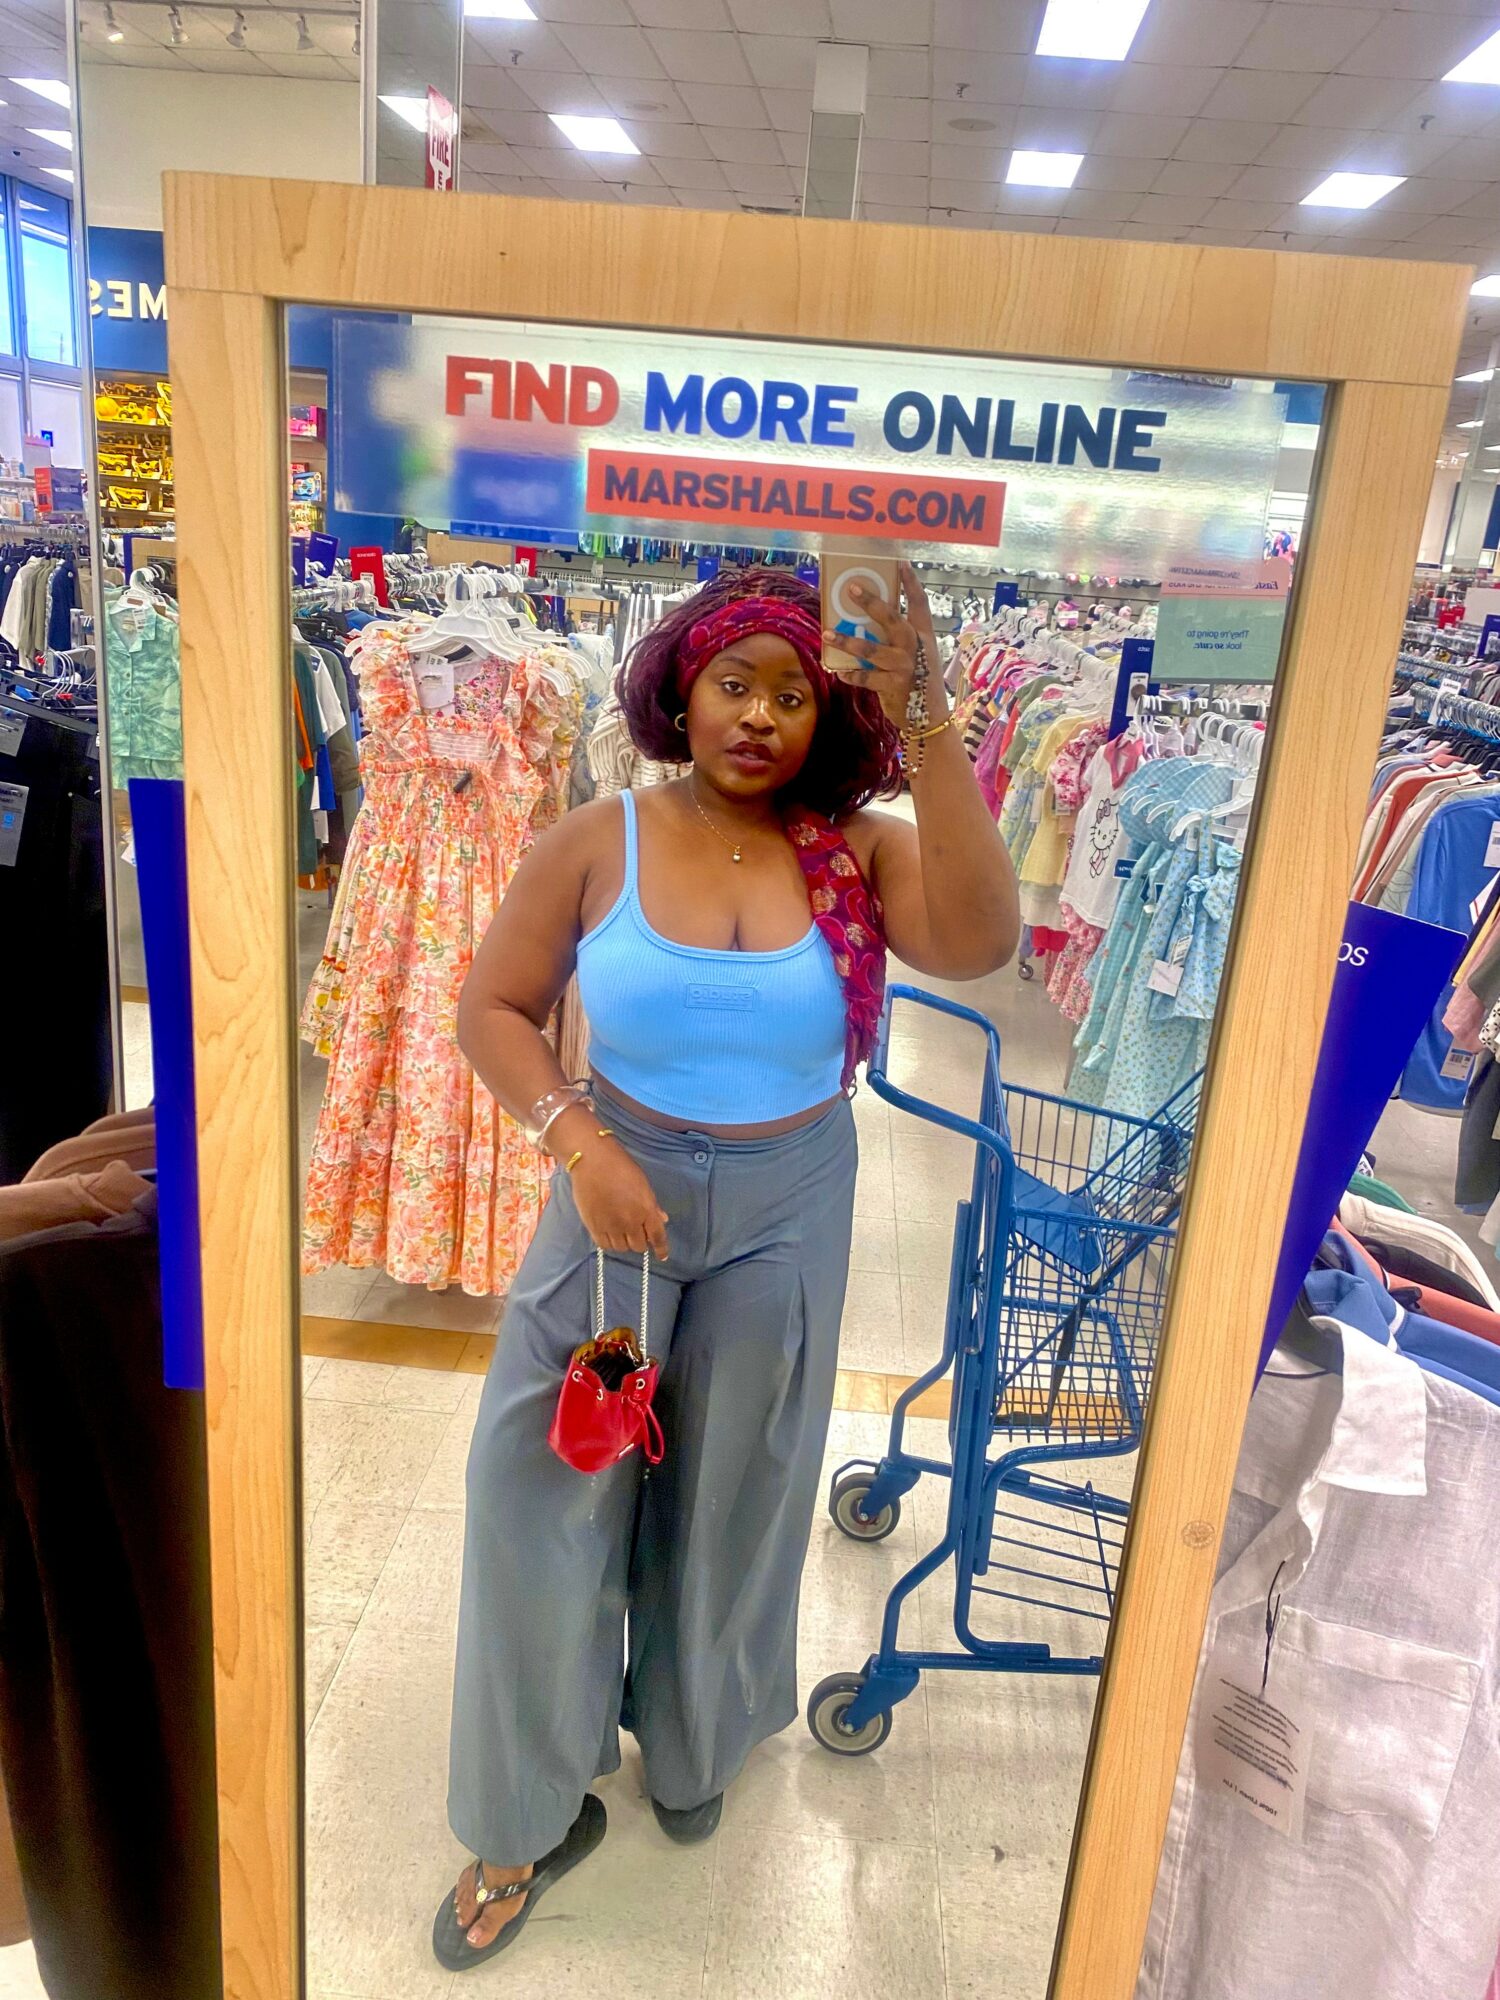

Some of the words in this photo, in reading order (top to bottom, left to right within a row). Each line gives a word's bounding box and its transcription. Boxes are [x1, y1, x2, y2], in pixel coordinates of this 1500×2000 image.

[431, 129, 449, 168] FIRE
[446, 355, 620, 427] FIND
[643, 370, 859, 448] MORE
[883, 390, 1167, 473] ONLINE
[604, 464, 987, 532] MARSHALLS.COM
